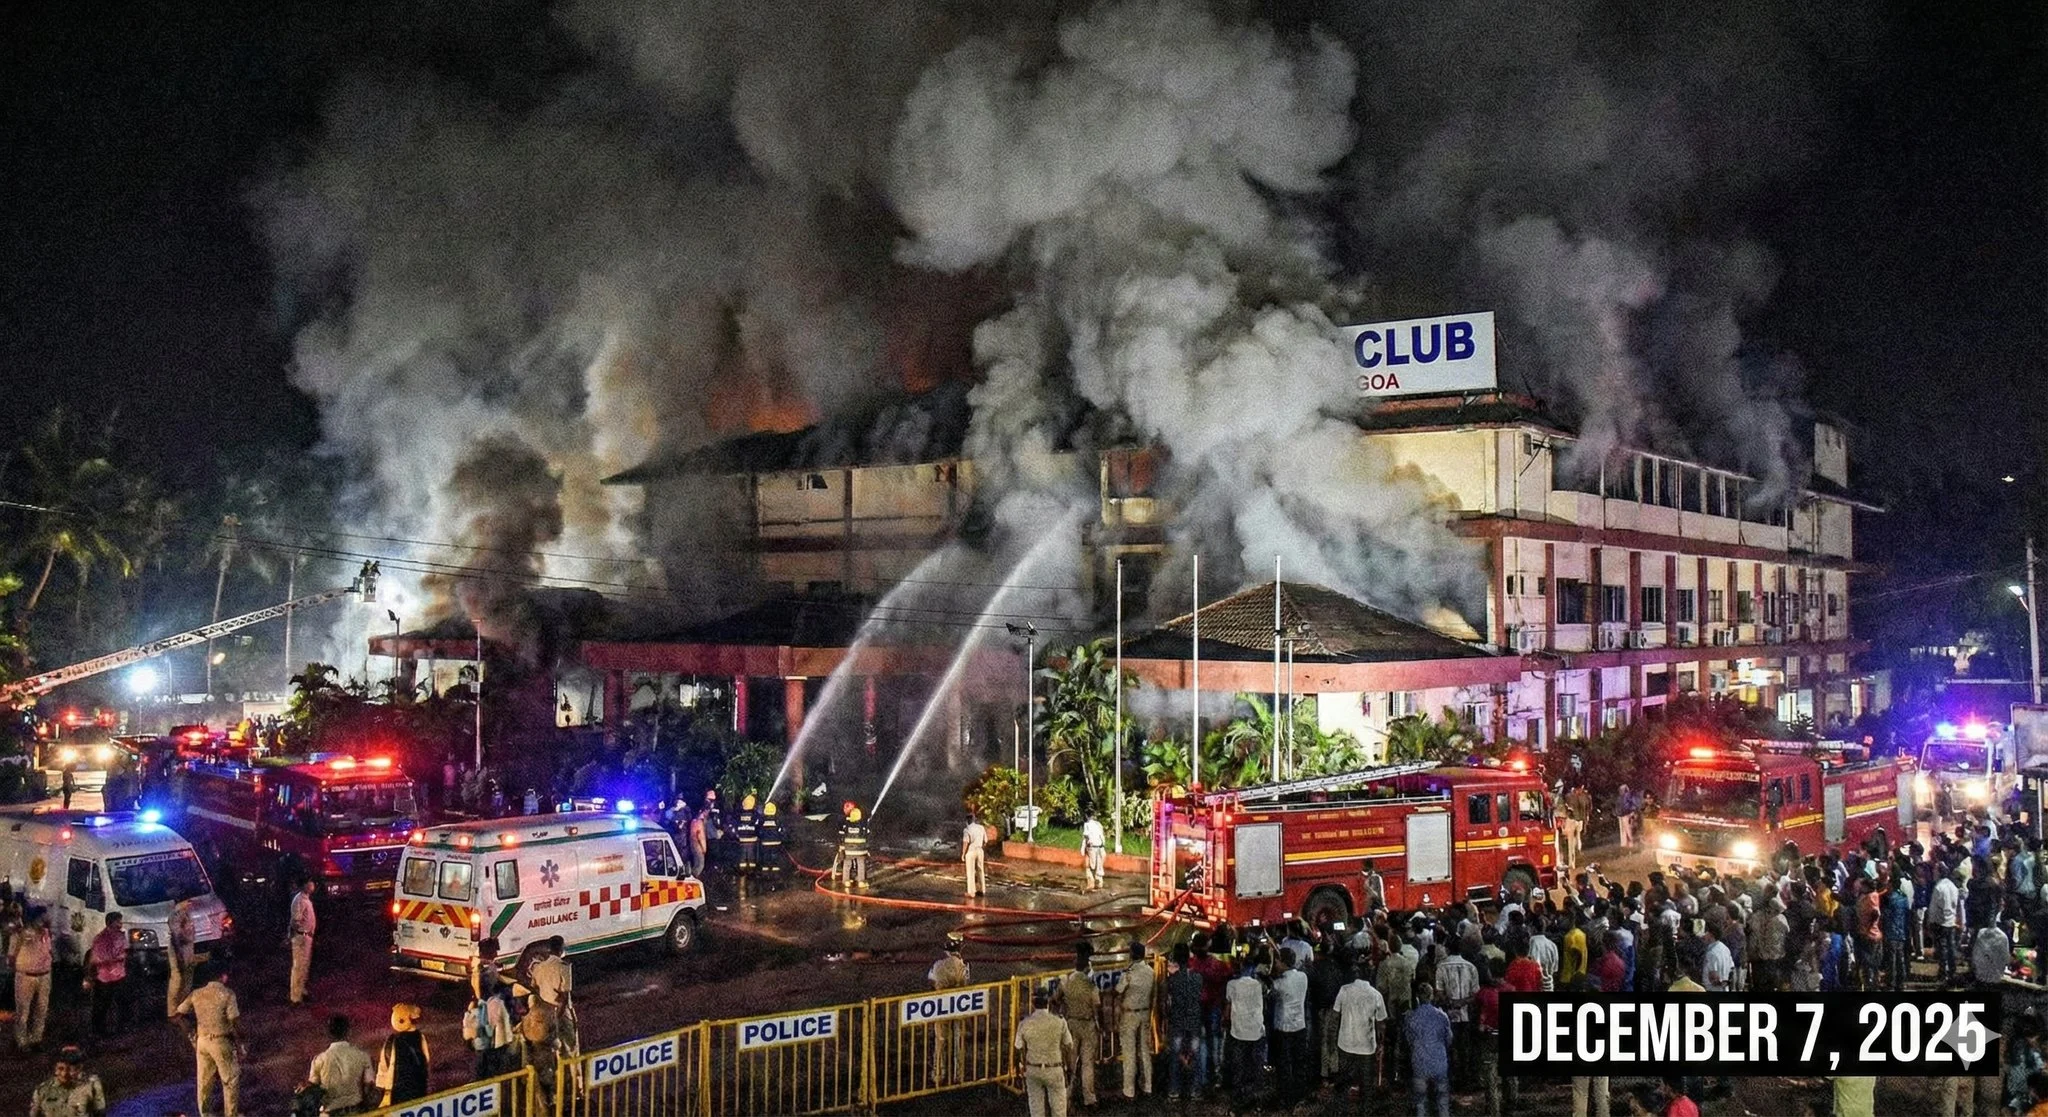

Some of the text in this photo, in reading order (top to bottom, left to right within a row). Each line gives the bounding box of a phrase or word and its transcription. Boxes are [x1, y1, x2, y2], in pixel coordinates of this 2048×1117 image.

[1355, 321, 1476, 368] CLUB
[1358, 373, 1400, 390] GOA
[528, 911, 578, 929] AMBULANCE
[906, 991, 984, 1021] POLICE
[744, 1014, 832, 1045] POLICE
[594, 1040, 673, 1081] POLICE
